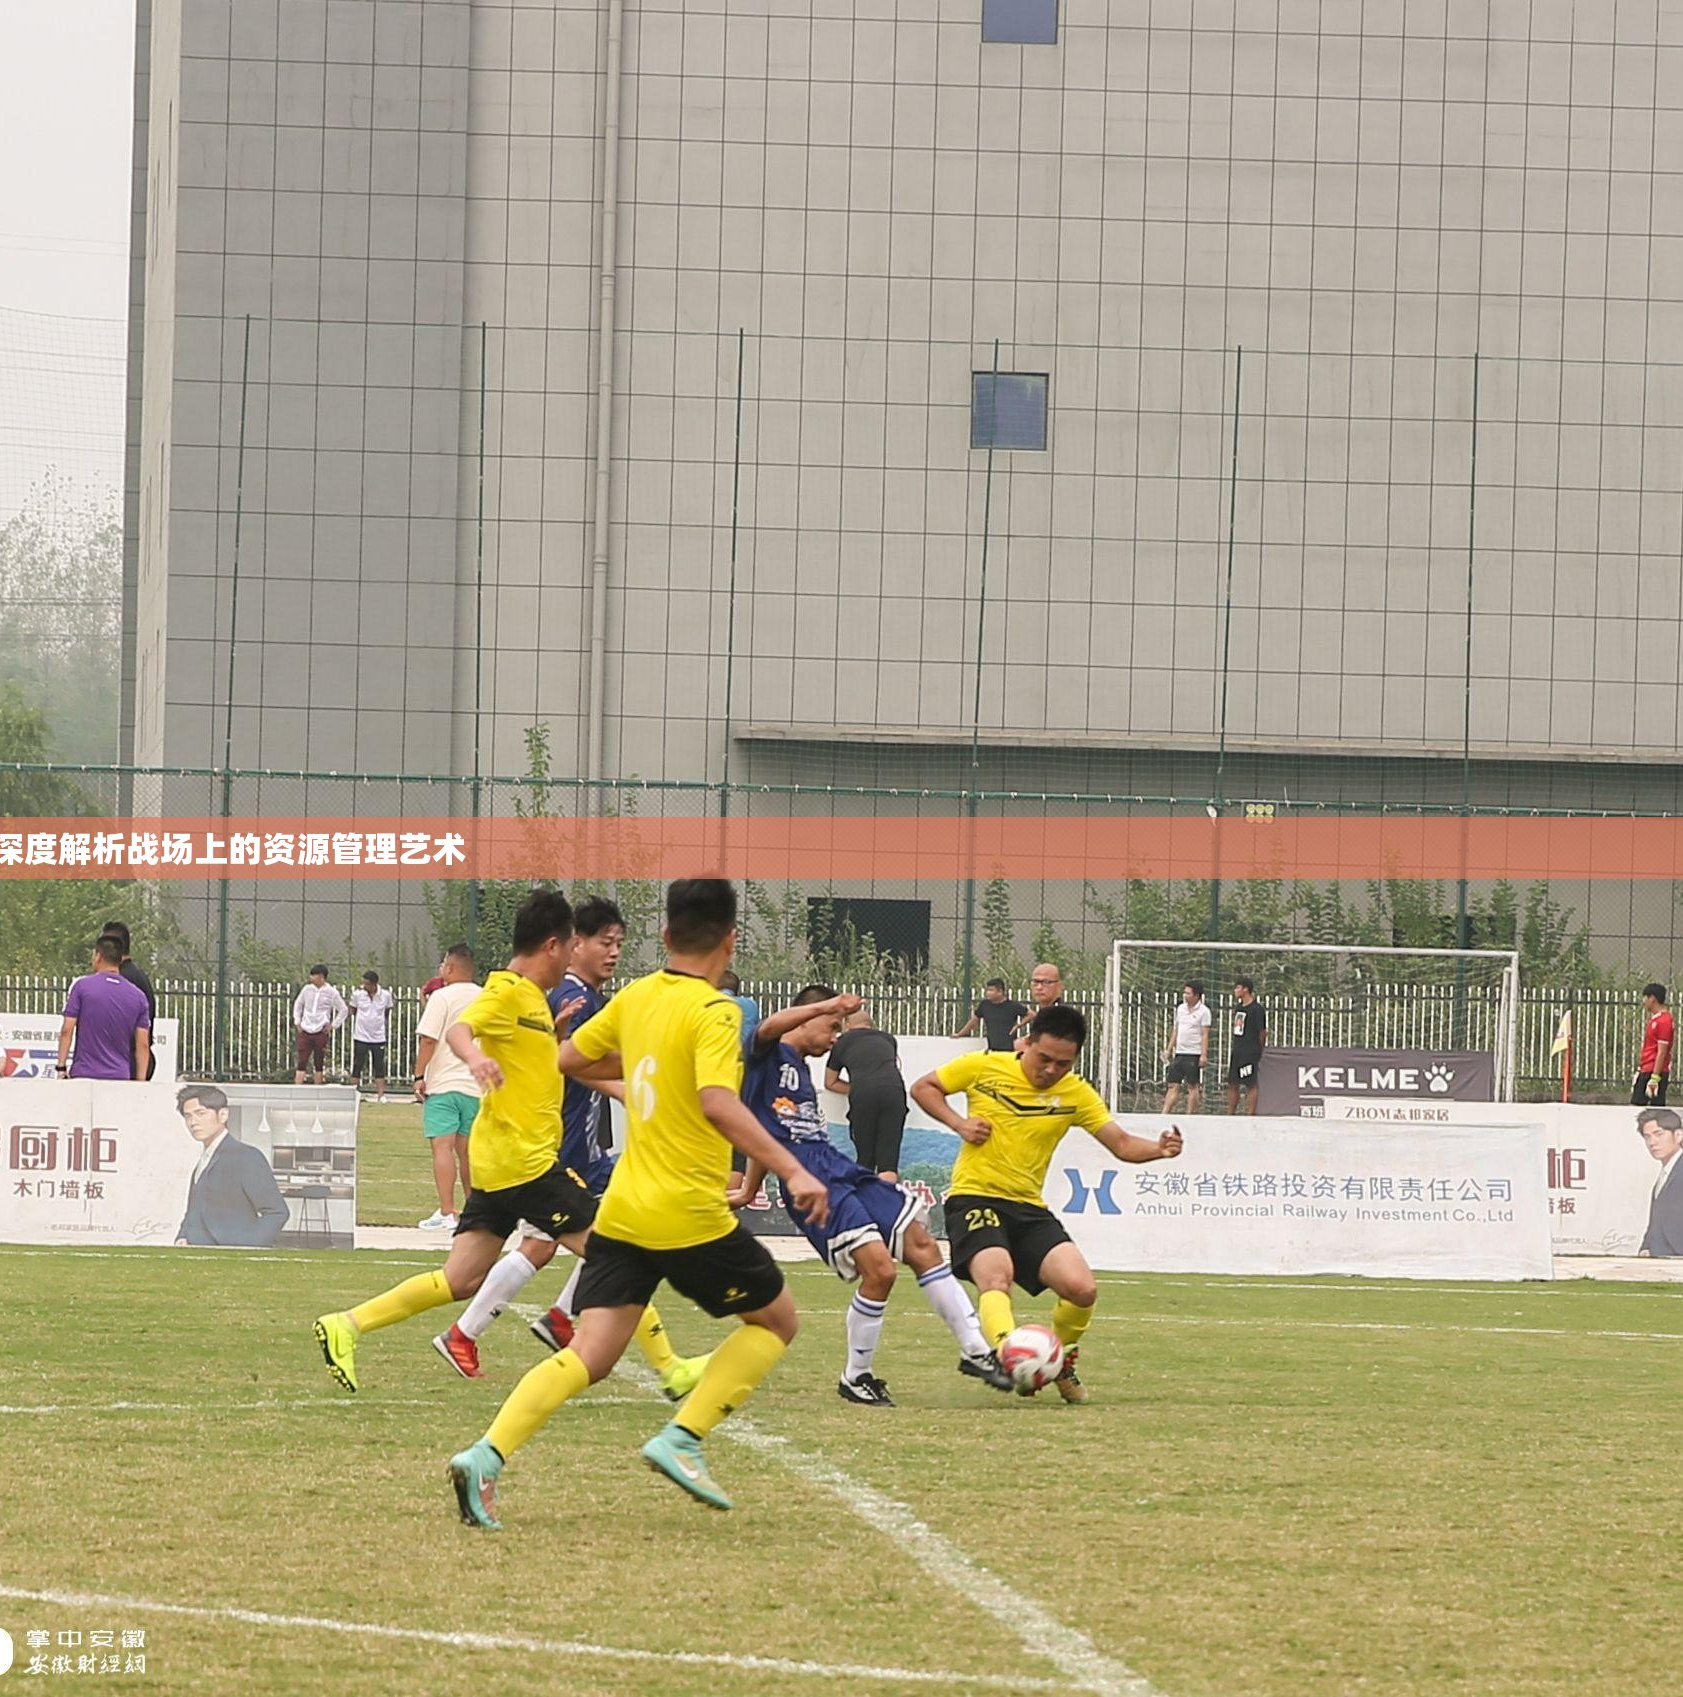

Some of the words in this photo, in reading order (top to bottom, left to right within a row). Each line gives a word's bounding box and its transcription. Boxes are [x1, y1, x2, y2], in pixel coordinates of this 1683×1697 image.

[632, 1055, 657, 1122] 6
[779, 1063, 800, 1092] 10
[1298, 1066, 1420, 1090] KELME
[1345, 1105, 1393, 1120] ZBOM
[13, 1179, 105, 1200] 木门墙板
[1134, 1171, 1512, 1203] 安徽省铁路投资有限责任公司
[965, 1208, 1001, 1231] 29
[1134, 1202, 1183, 1215] Anhui
[1191, 1203, 1274, 1217] Provincial
[1283, 1204, 1347, 1221] Railway
[1356, 1207, 1449, 1221] Investment
[1453, 1207, 1514, 1222] Co.,Ltd
